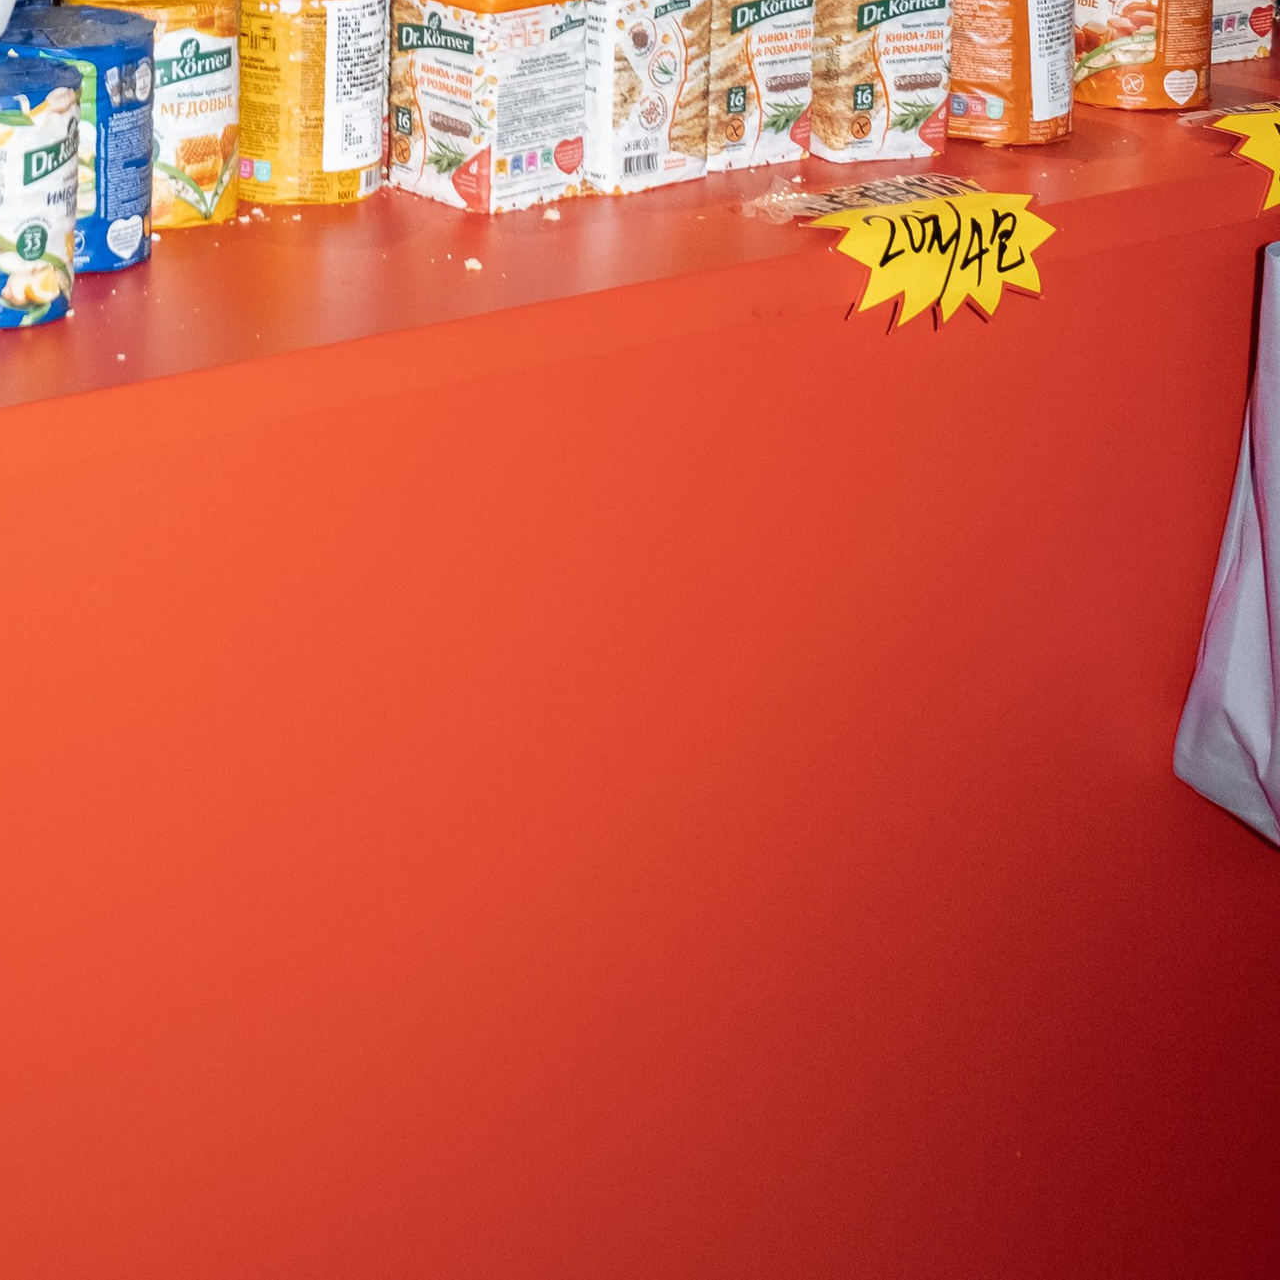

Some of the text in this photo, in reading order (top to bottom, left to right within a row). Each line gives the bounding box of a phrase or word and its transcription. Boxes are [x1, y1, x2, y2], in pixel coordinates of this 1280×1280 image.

[736, 7, 760, 28] Dr.
[862, 5, 887, 25] Dr.
[401, 27, 471, 51] Dr. Körner
[757, 29, 812, 46] КИНОА ЛЕН
[885, 29, 945, 44] КИНОА ЛЕН
[755, 41, 812, 58] & РОЗМАРИН
[882, 41, 944, 57] & РОЗМАРИН
[173, 51, 229, 78] Körner
[421, 62, 473, 87] КИНОА ЛЕН
[426, 77, 473, 101] РОЗМАРИН
[855, 90, 872, 105] 16
[160, 95, 234, 117] МЕДОВЫЕ
[729, 92, 746, 107] 16
[397, 111, 411, 129] 16
[31, 150, 58, 178] Dr.
[23, 233, 42, 253] 33
